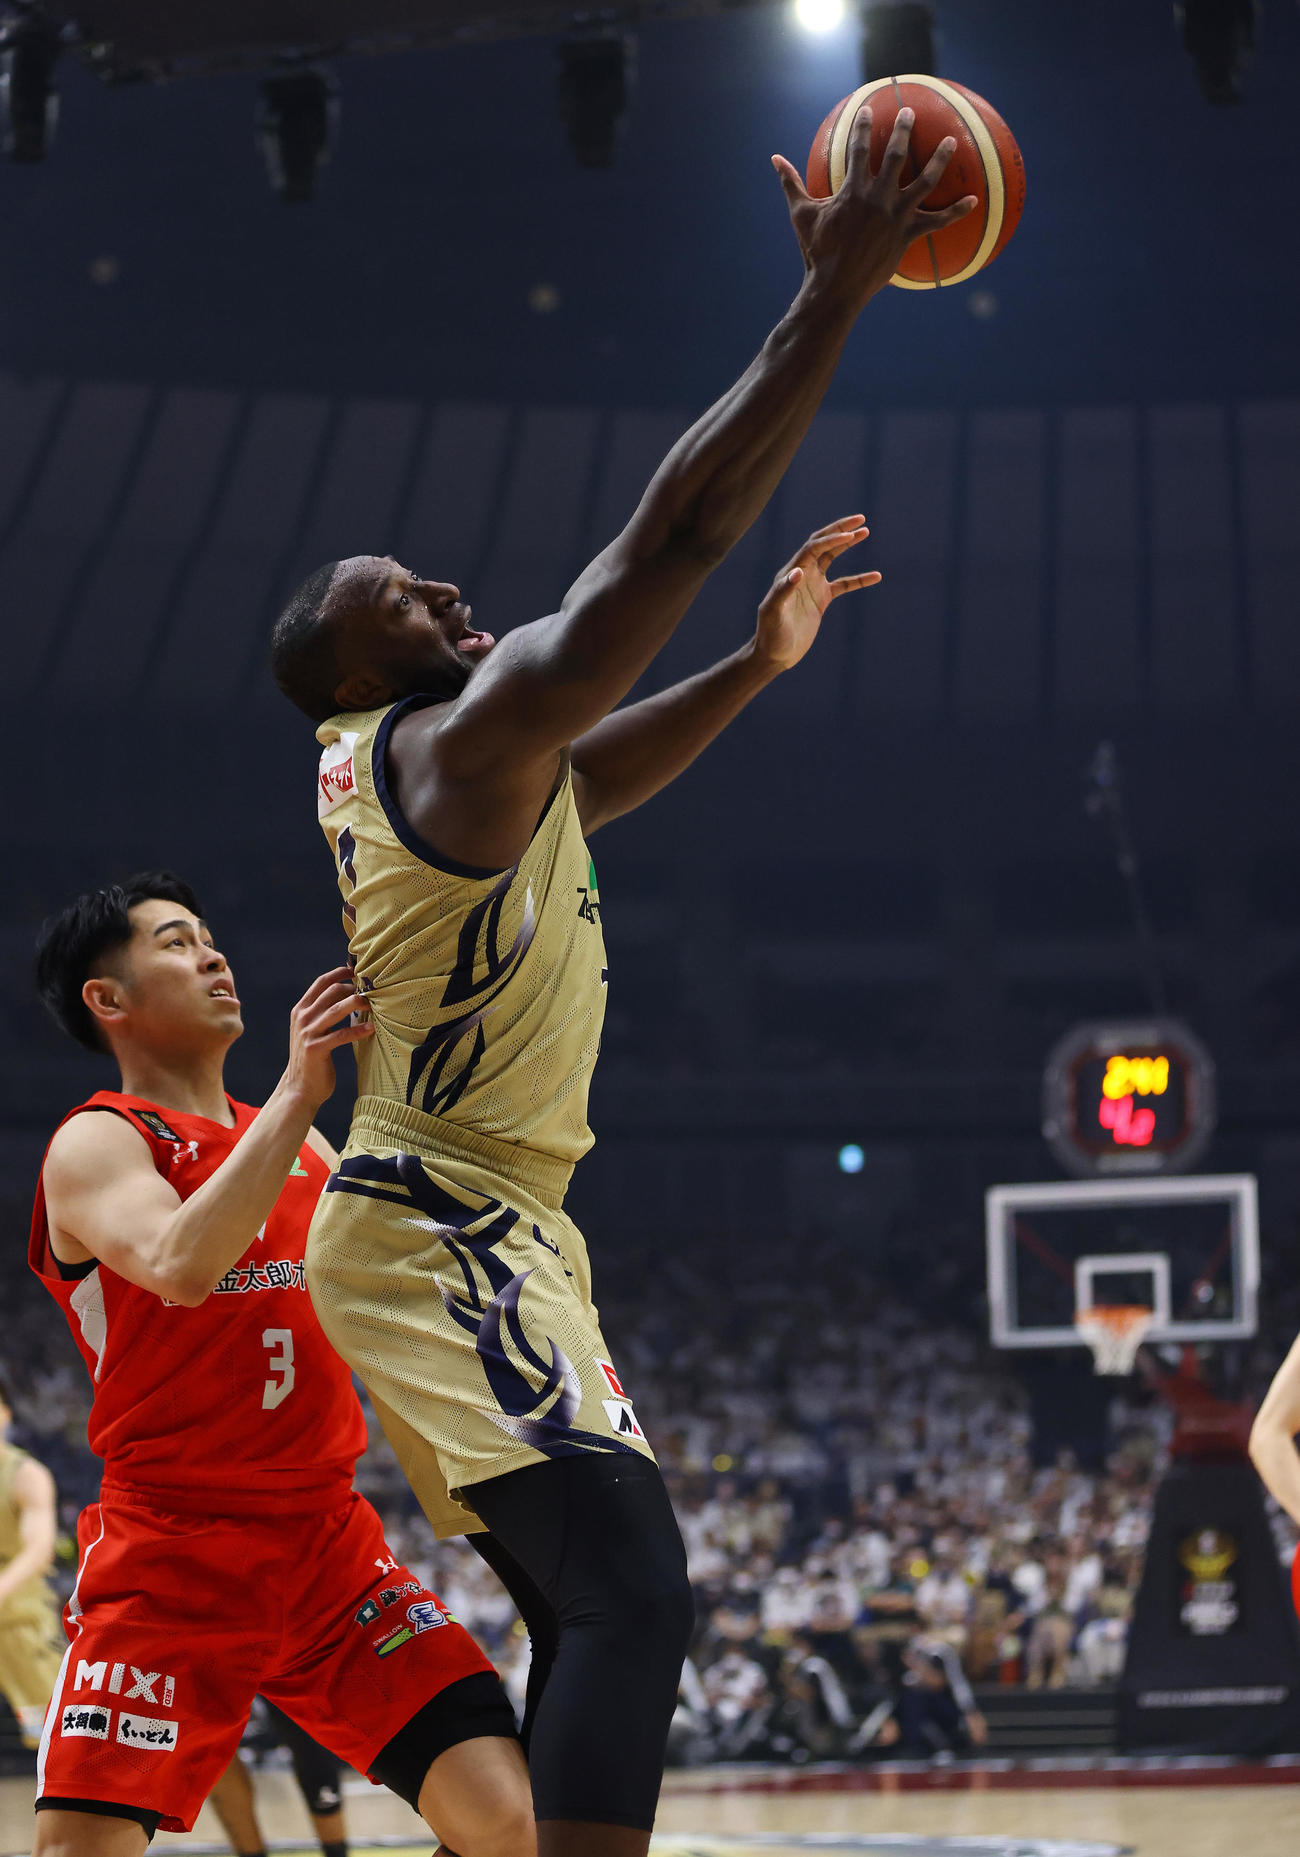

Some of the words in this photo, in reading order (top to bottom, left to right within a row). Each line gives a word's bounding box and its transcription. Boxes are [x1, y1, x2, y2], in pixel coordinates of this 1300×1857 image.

[261, 1328, 295, 1411] 3
[372, 1623, 404, 1646] SWALLOW
[164, 1688, 173, 1706] RED
[121, 1718, 174, 1745] くいどん
